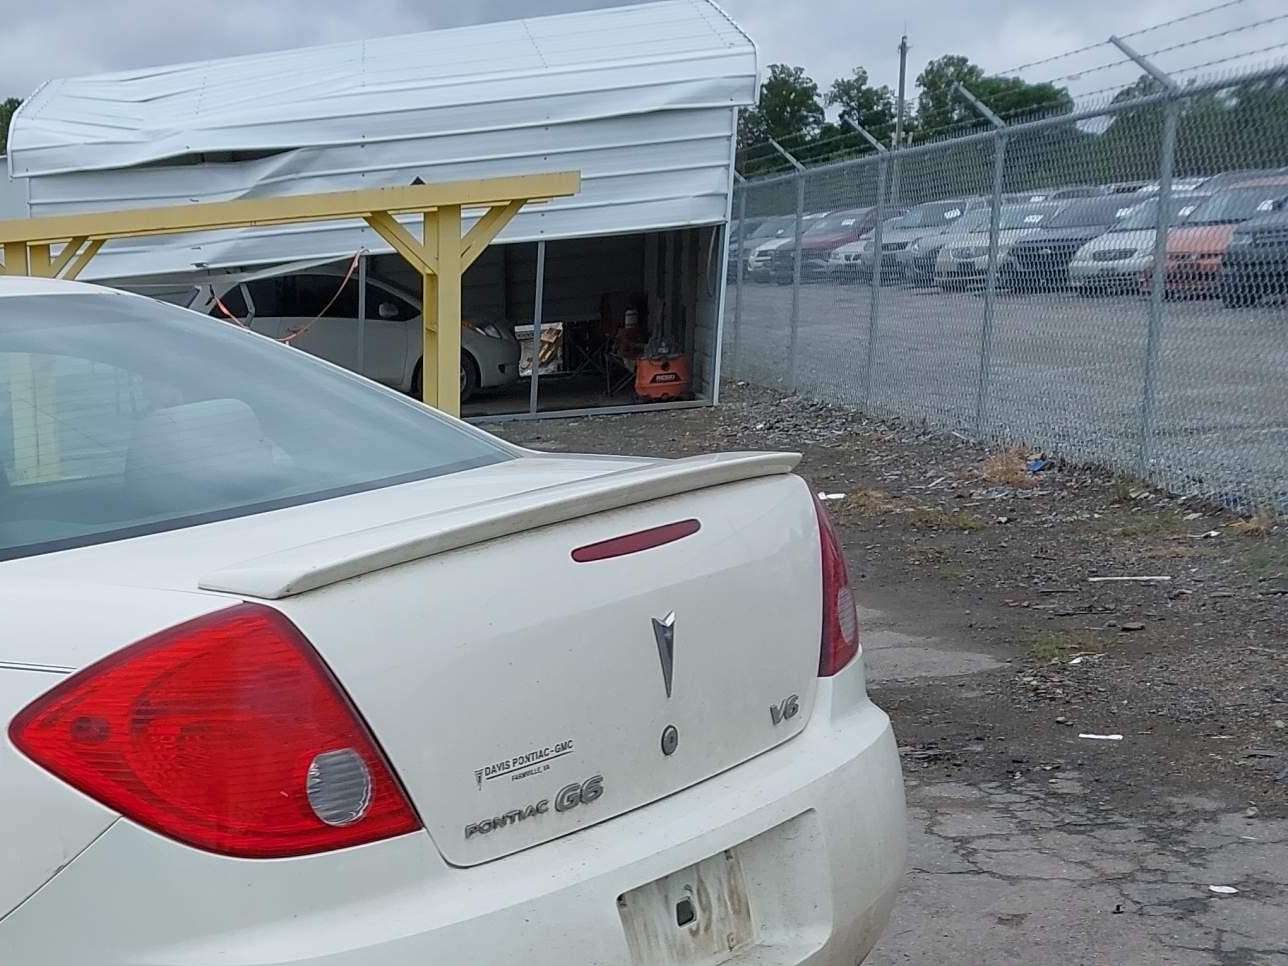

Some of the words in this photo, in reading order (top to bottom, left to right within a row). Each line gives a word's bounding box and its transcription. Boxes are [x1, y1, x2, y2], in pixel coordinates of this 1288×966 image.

[769, 694, 799, 726] V6
[484, 760, 511, 777] DAVIS
[512, 739, 574, 768] PONTIAC-GMC
[465, 799, 549, 839] PONTIAC
[554, 775, 604, 813] G6
